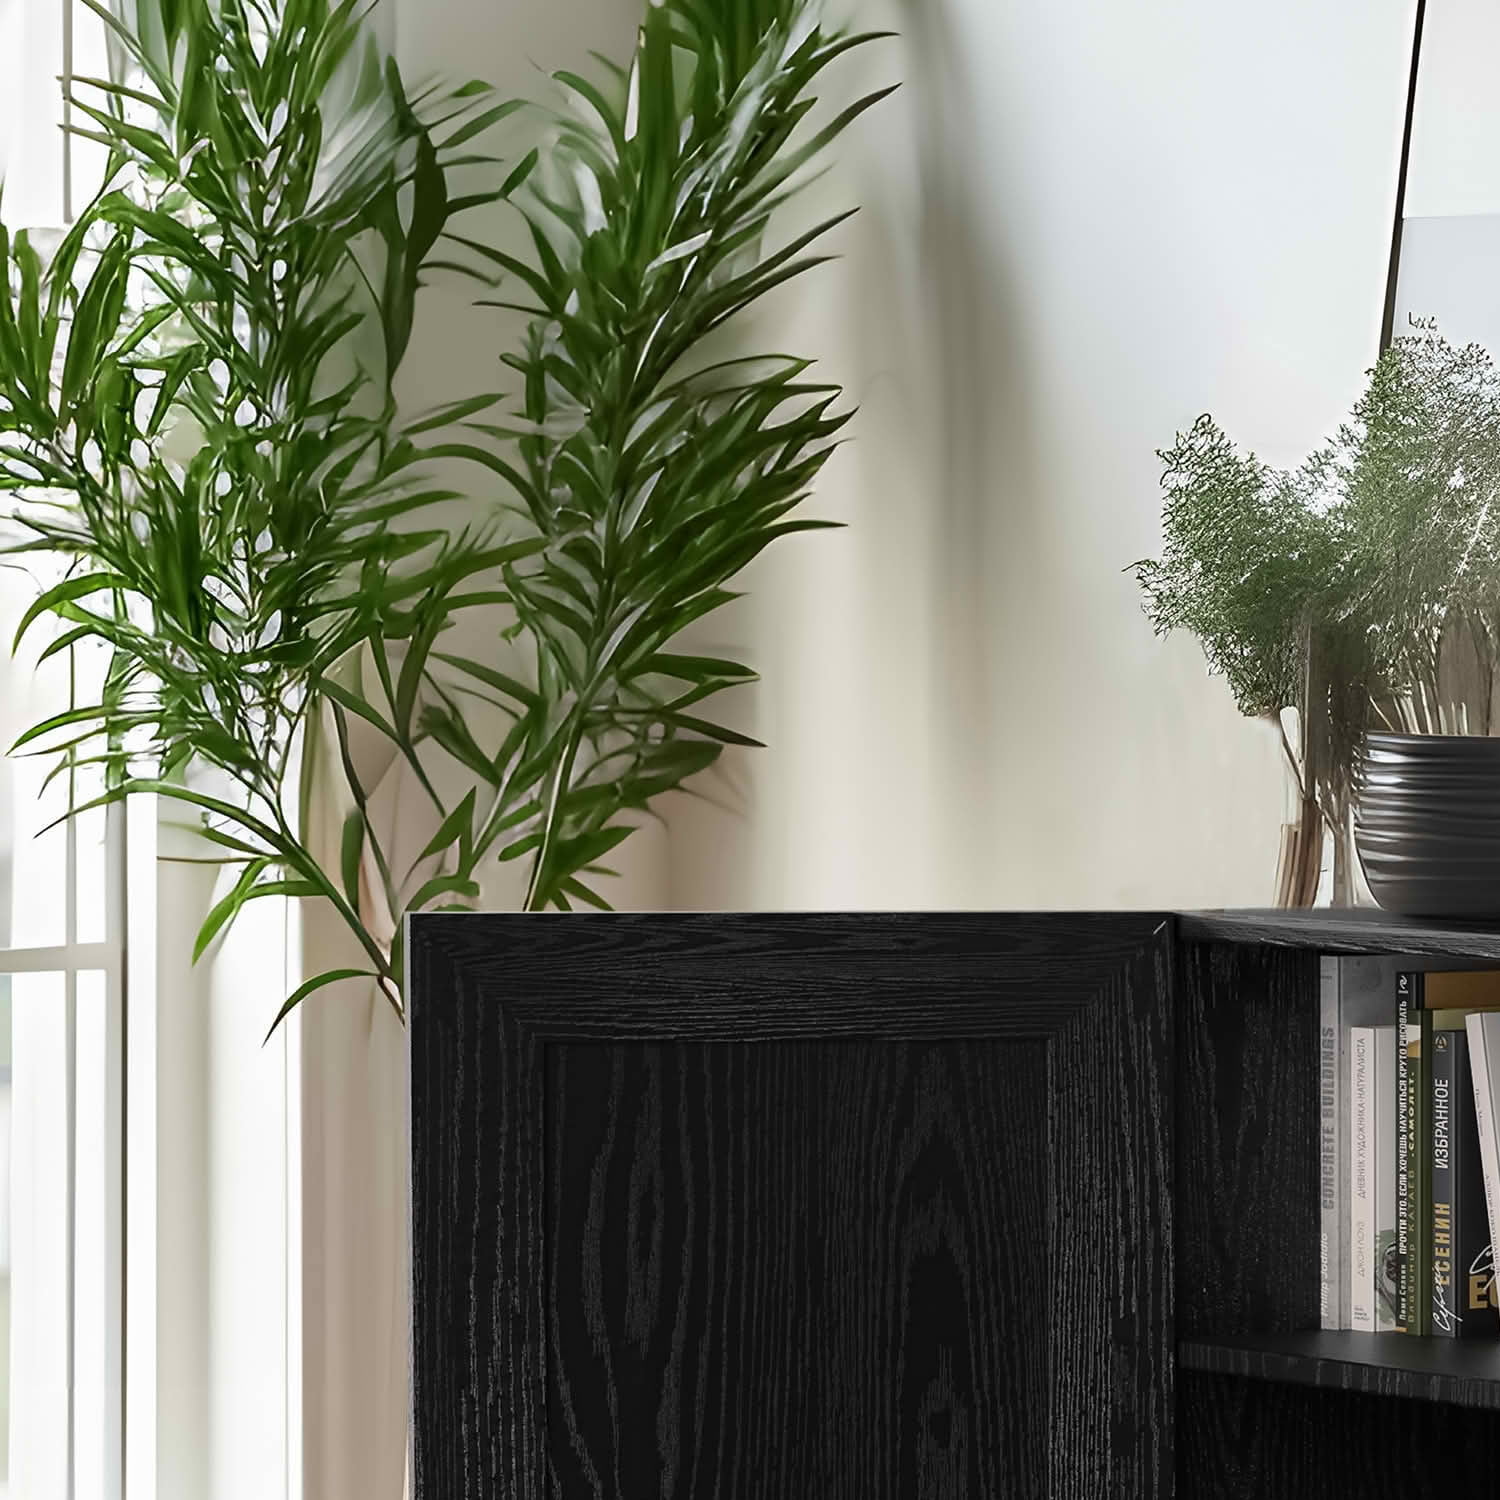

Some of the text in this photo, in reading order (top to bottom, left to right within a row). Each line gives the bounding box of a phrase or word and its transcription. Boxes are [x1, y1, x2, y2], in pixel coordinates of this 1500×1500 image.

[1398, 1001, 1407, 1047] РИСОВАТЬ
[1321, 1027, 1335, 1119] BUILDINGS
[1398, 1048, 1407, 1078] КРУТО
[1398, 1080, 1407, 1133] НАУЧИТЬСЯ
[1321, 1127, 1335, 1210] CONCRETE
[1398, 1135, 1407, 1172] ХОЧЕШЬ
[1356, 1160, 1367, 1200] ДНЕВНИК
[1398, 1173, 1407, 1197] ЕСЛИ
[1434, 1078, 1451, 1287] ЕСЕНИН ИЗБРАННОЕ
[1398, 1219, 1407, 1255] ПРОЧТИ
